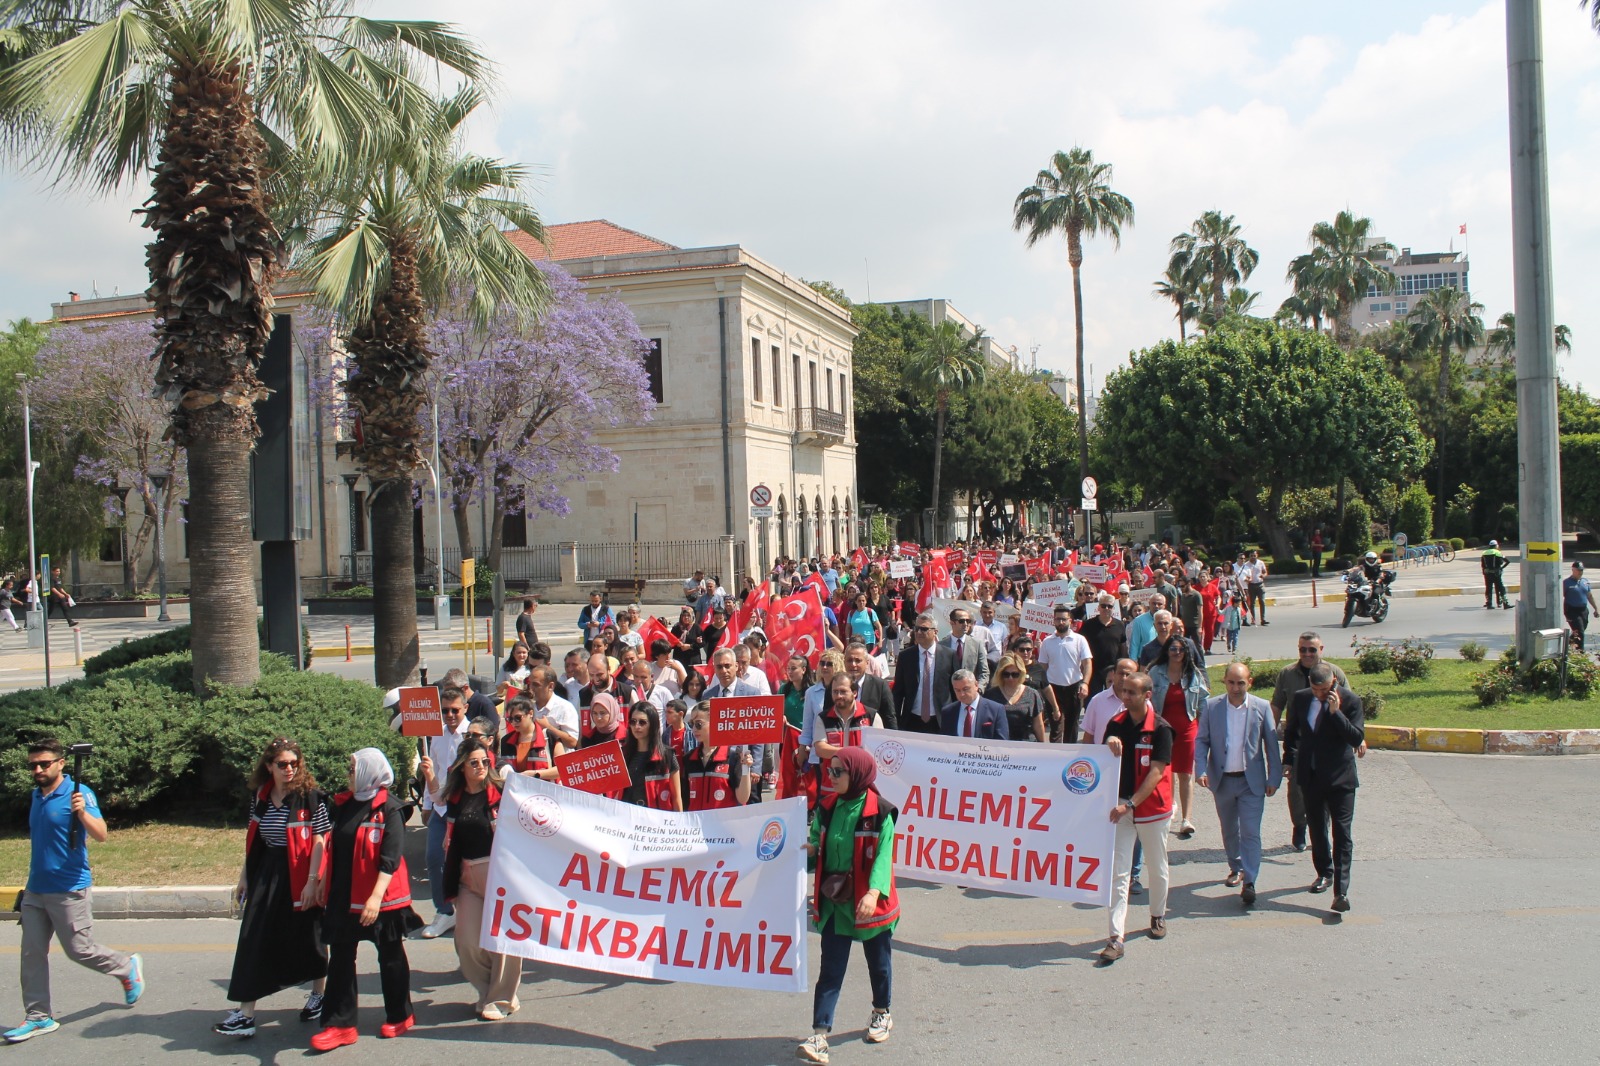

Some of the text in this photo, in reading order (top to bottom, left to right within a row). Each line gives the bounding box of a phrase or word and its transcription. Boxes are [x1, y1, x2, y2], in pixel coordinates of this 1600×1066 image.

[409, 698, 432, 708] AİLEMİZ
[402, 710, 440, 720] İSTİKBALİMİZ
[719, 706, 775, 719] BİZ BÜYÜK
[717, 718, 776, 731] BİR AİLEYİZ
[958, 751, 1010, 762] MERSİN VALİLİĞİ
[566, 754, 616, 774] BİZ BÜYÜK
[927, 756, 952, 765] MERSİN
[977, 761, 1000, 769] SOSYAL
[1001, 763, 1037, 772] HİZMETLER
[954, 765, 1003, 777] İL MÜDÜRLÜĞÜ
[568, 764, 621, 786] BİR AİLEYİZ
[901, 776, 1052, 832] AİLEMİZ
[594, 824, 736, 844] MERSİN AİLE VE SOSYAL HİZMETLER
[634, 824, 701, 836] MERSİN VALİLİĞİ
[633, 843, 641, 852] İL
[892, 824, 1101, 892] TİKBALİMİZ
[558, 851, 743, 909] AİLEMİZ
[490, 886, 794, 976] İSTİKBALİMİZ
